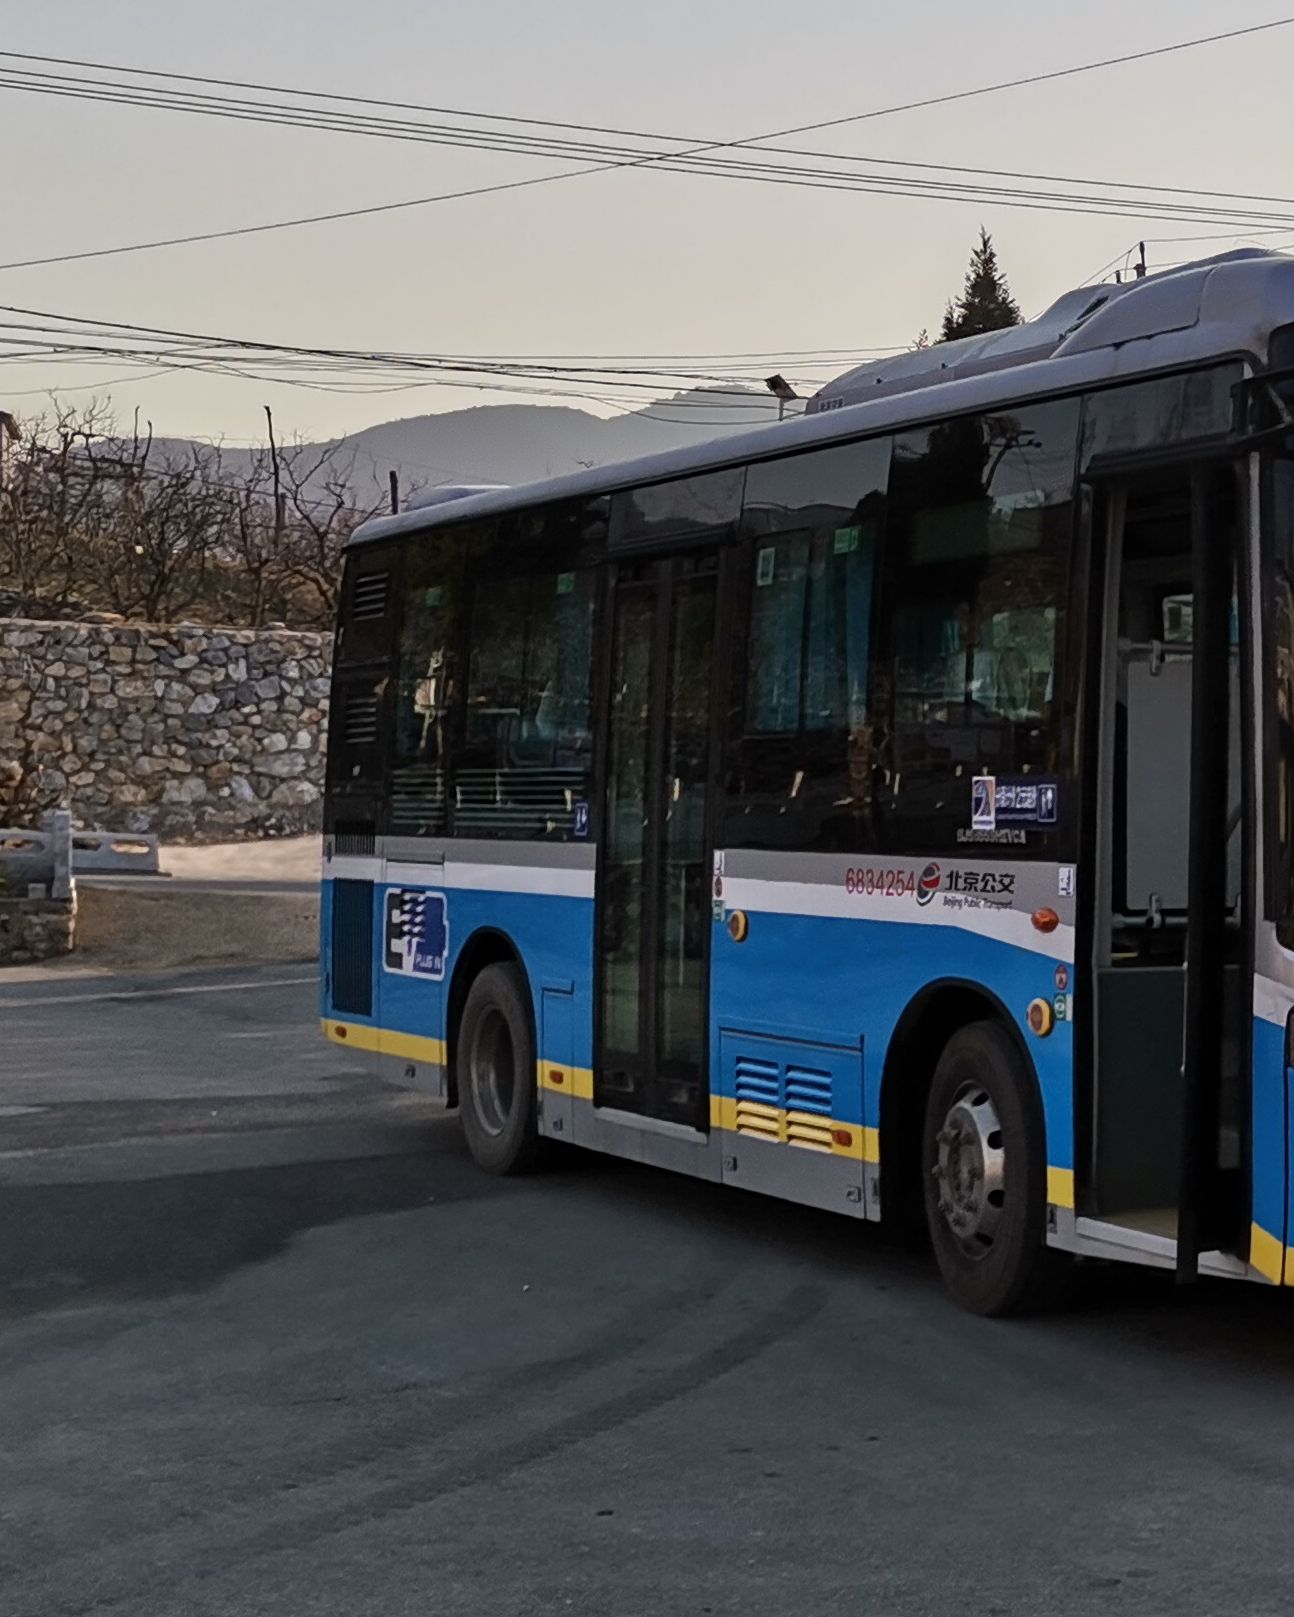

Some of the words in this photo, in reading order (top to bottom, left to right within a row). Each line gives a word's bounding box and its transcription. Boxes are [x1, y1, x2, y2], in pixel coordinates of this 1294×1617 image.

[845, 867, 916, 897] 6834254
[944, 869, 1015, 895] 北京公交
